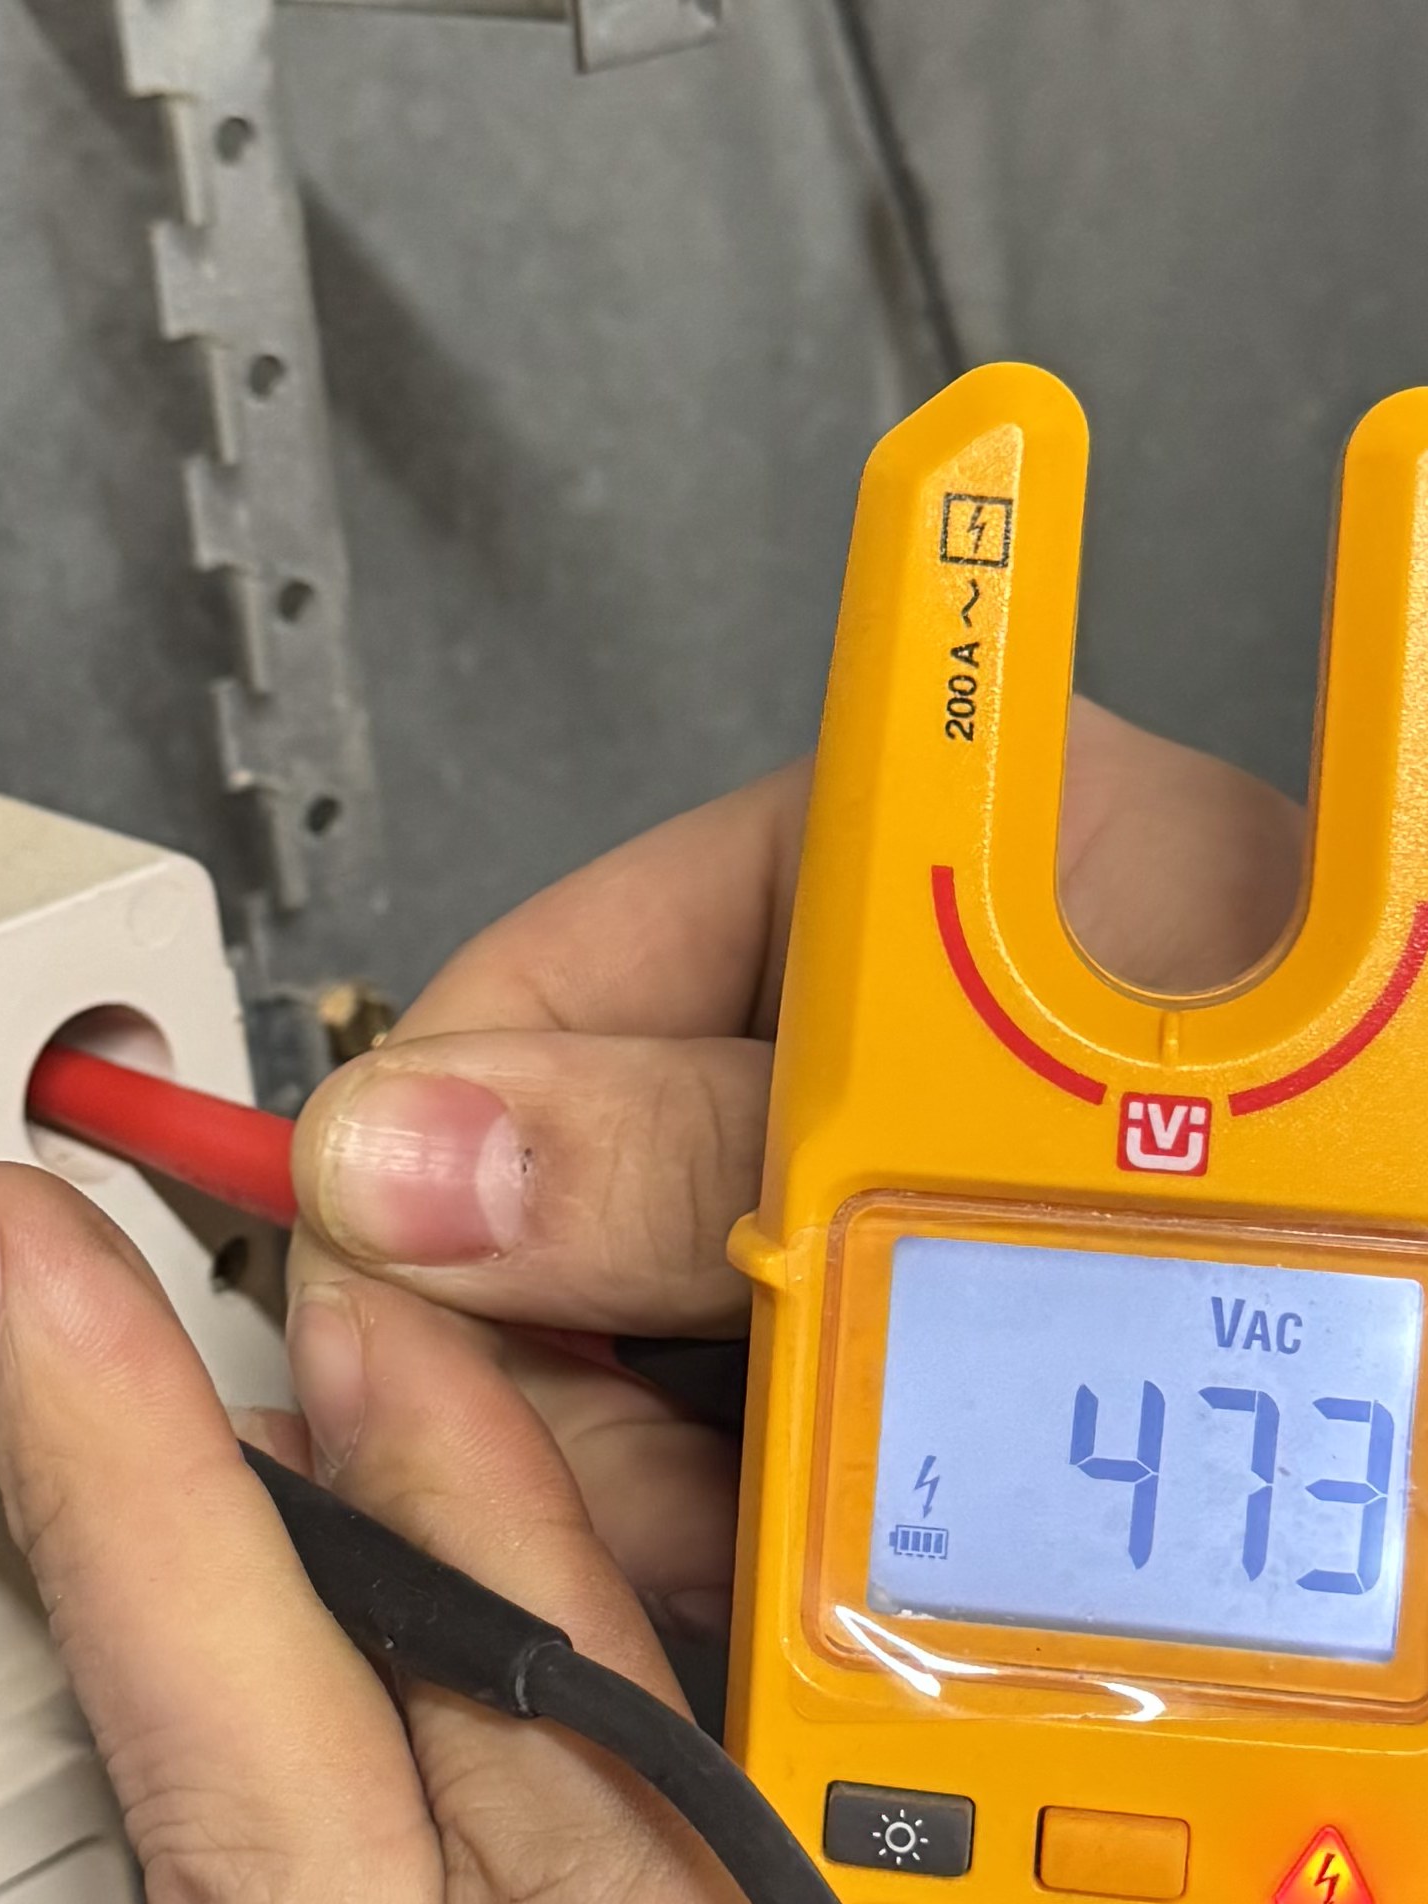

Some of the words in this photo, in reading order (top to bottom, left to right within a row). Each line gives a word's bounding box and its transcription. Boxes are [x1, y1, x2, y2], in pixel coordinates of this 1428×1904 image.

[950, 641, 980, 668] A
[944, 674, 977, 742] 200
[1070, 1379, 1395, 1596] 473
